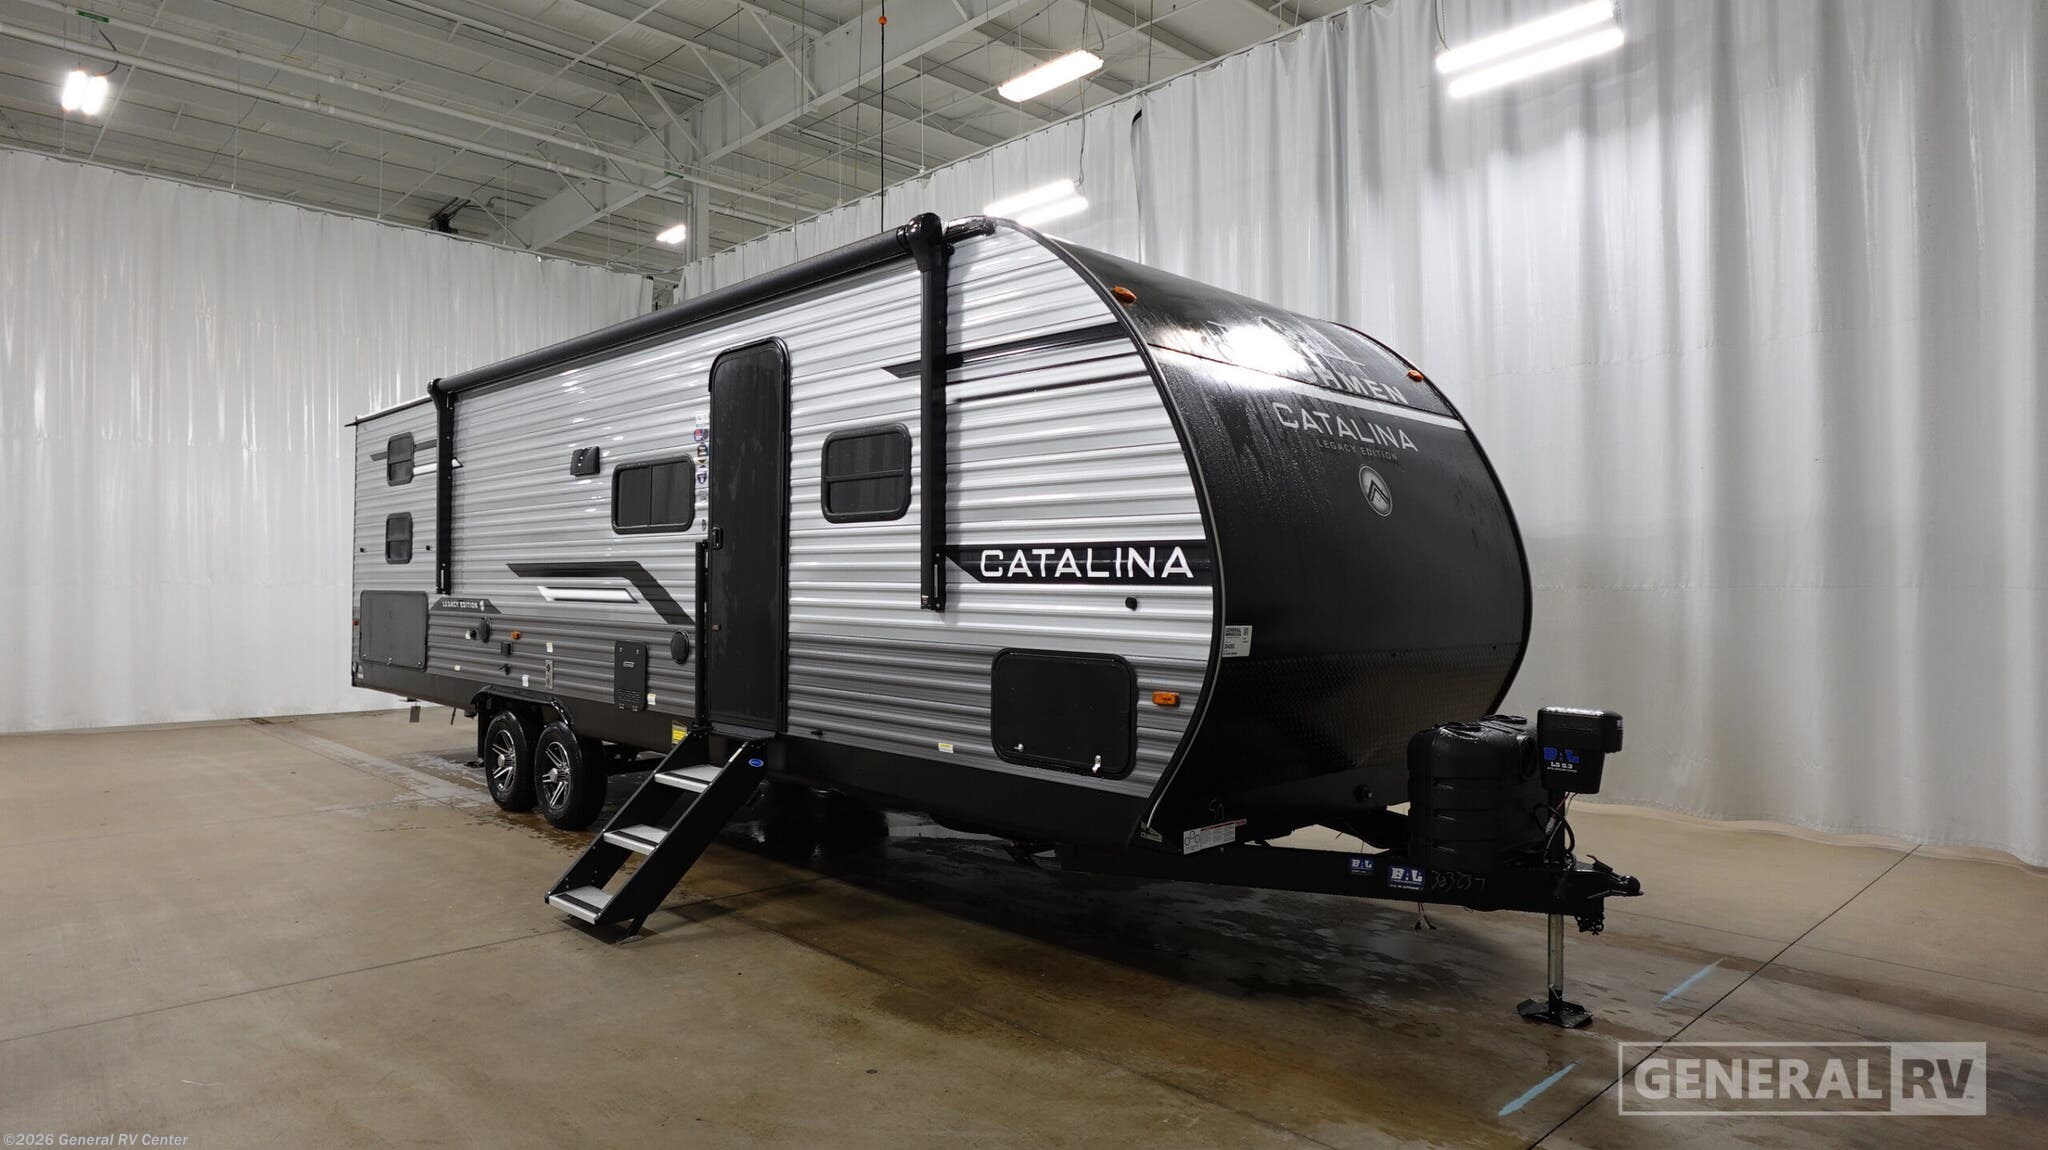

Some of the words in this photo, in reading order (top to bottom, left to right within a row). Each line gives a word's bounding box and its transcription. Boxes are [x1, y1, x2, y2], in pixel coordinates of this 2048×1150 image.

[1272, 401, 1419, 453] CATALINA
[1316, 439, 1356, 453] LEGACY
[1360, 446, 1398, 461] EDITION
[979, 546, 1194, 578] CATALINA
[1391, 867, 1423, 882] BAL
